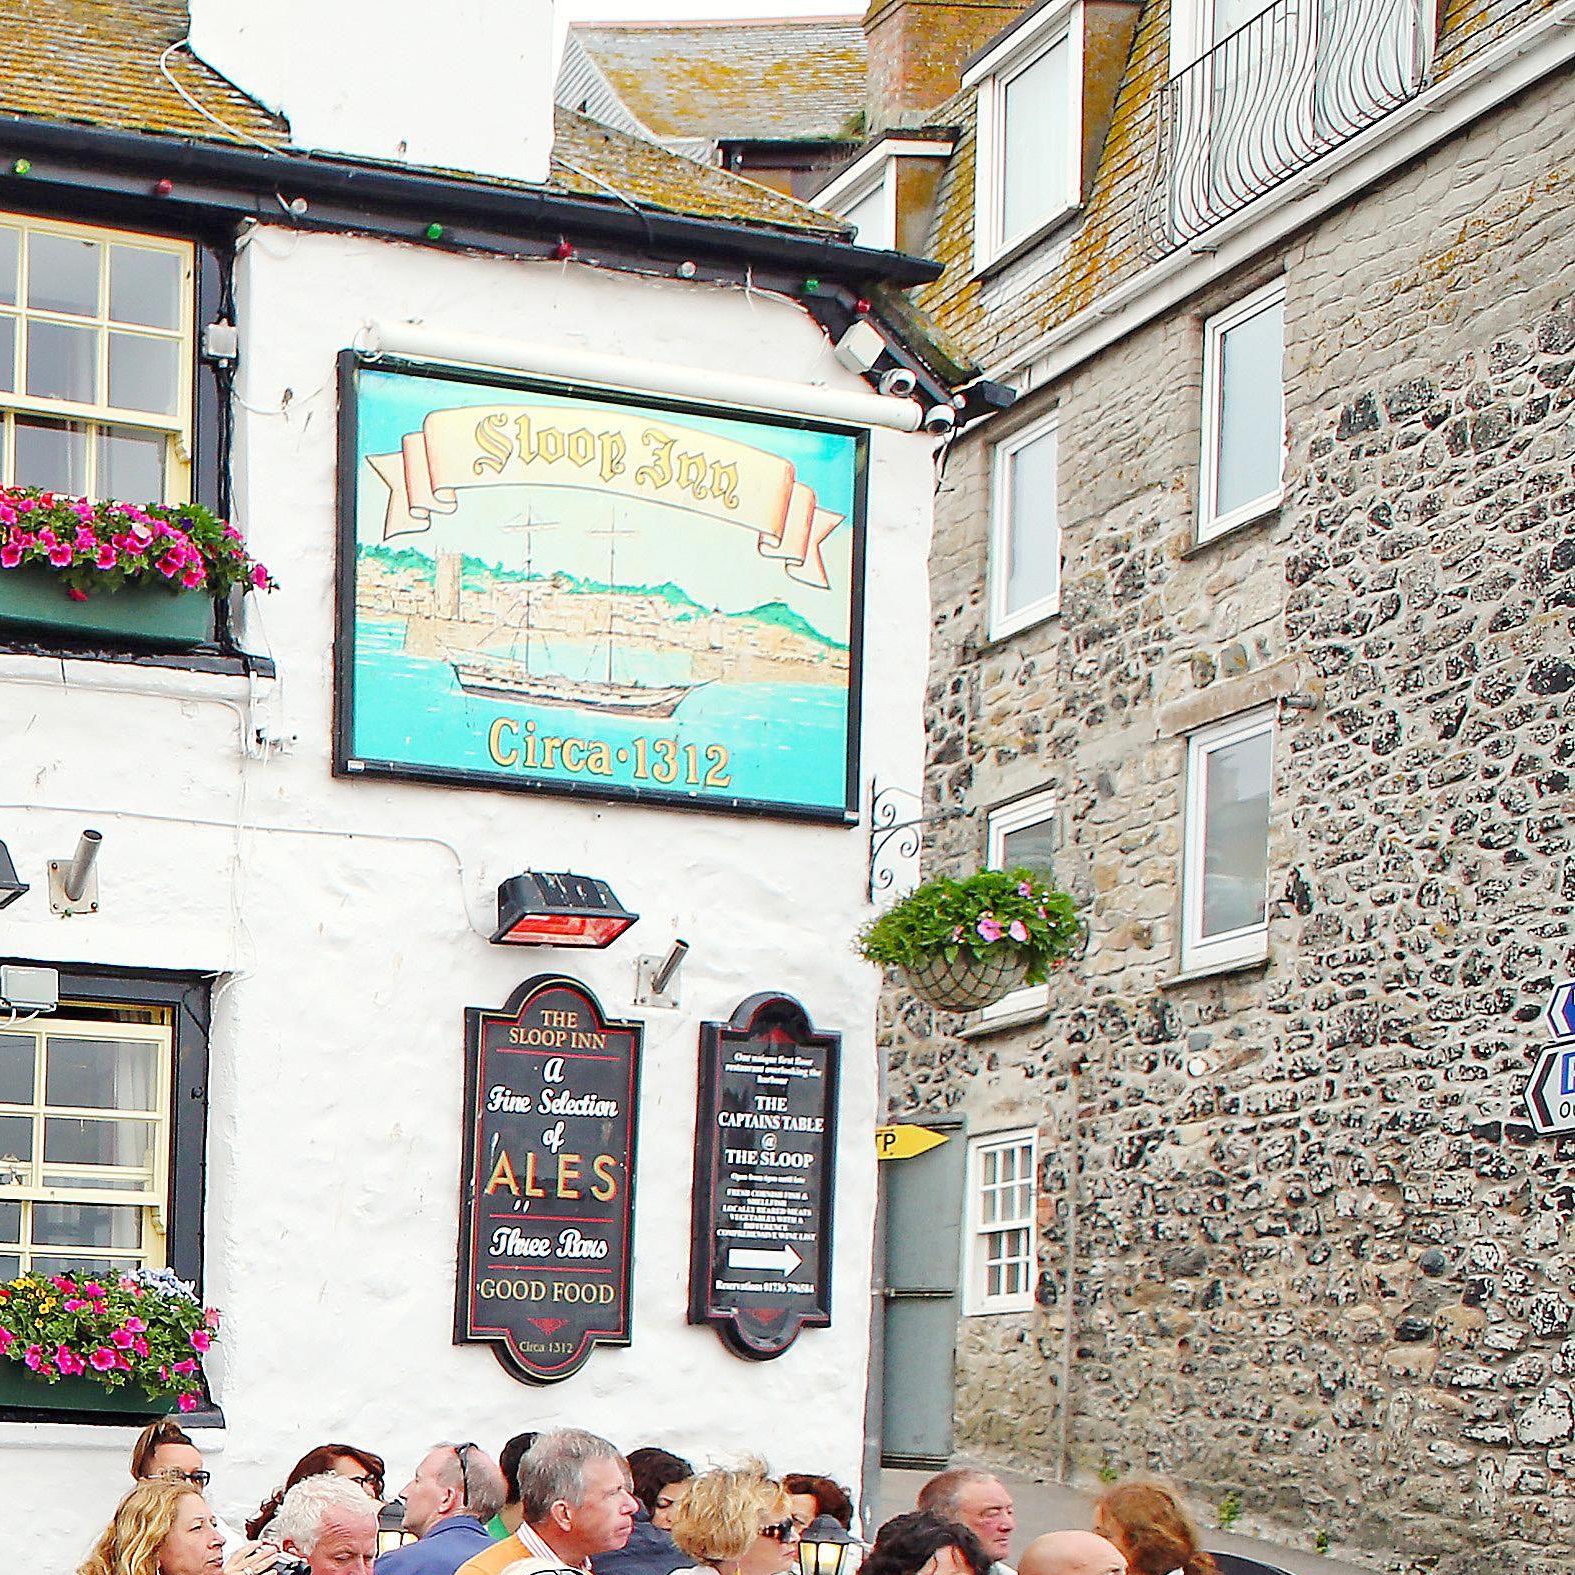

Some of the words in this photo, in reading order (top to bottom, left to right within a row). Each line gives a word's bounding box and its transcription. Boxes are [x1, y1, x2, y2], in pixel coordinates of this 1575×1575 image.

[474, 414, 626, 482] Sloop
[636, 434, 739, 509] Inn
[488, 718, 612, 775] Circa
[634, 737, 731, 787] 1312
[541, 1010, 577, 1027] THE
[509, 1026, 567, 1047] SLOOP
[571, 1031, 606, 1050] INN
[487, 1086, 531, 1113] Fine
[537, 1088, 618, 1118] Selection
[755, 1095, 788, 1111] THE
[718, 1112, 781, 1130] CAPTAINS
[783, 1116, 824, 1132] TABLE
[543, 1122, 564, 1153] of
[761, 1134, 777, 1149] @
[725, 1149, 758, 1166] THE
[760, 1150, 814, 1168] SLOOP
[484, 1151, 618, 1202] ALES
[489, 1228, 551, 1257] Three
[556, 1228, 609, 1259] Bars
[480, 1279, 546, 1301] GOOD
[552, 1281, 615, 1304] FOOD
[519, 1340, 545, 1353] Circa
[548, 1341, 574, 1354] 1312
